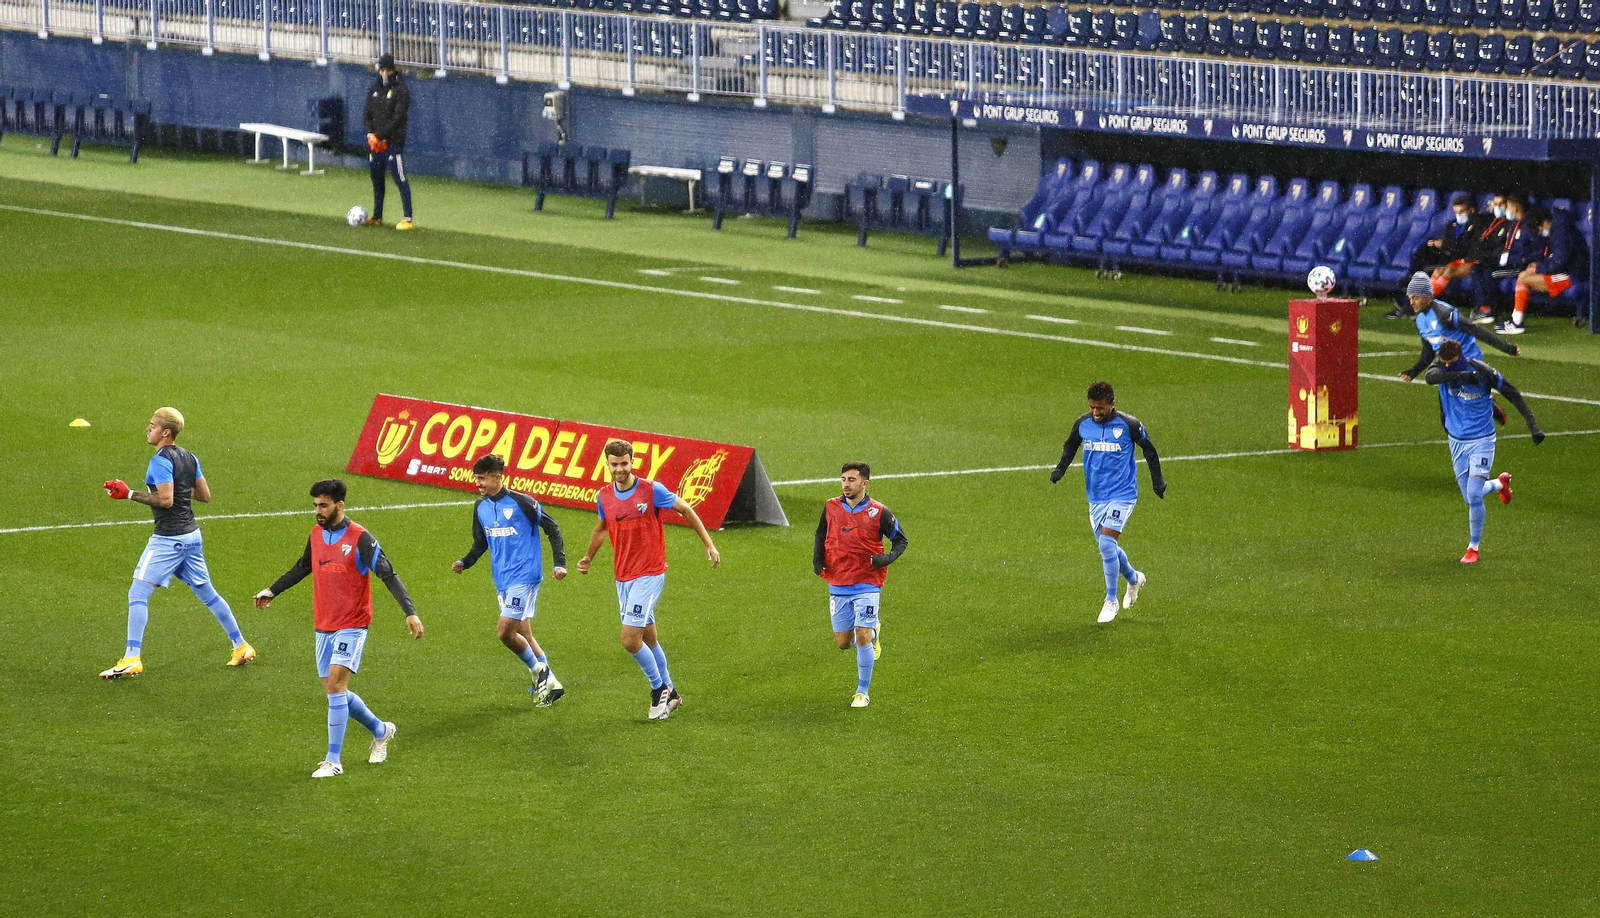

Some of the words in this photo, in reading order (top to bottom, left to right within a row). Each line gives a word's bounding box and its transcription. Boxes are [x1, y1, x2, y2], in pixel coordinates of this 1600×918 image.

[983, 104, 1003, 119] PONT
[1004, 106, 1025, 121] GRUP
[1025, 108, 1059, 125] SEGUROS
[1108, 115, 1130, 129] PONT
[1130, 115, 1152, 131] GRUP
[1153, 117, 1188, 134] SEGUROS
[1242, 123, 1265, 139] PONT
[1265, 125, 1288, 141] GRUP
[1289, 127, 1326, 144] SEGUROS
[1376, 133, 1400, 148] PONT
[1401, 134, 1424, 150] GRUP
[1425, 136, 1464, 153] SEGUROS
[418, 411, 517, 468] COPA
[516, 425, 589, 480] DEL
[420, 463, 447, 477] SEAT
[448, 466, 477, 484] SOMO
[510, 476, 547, 496] SOMOS
